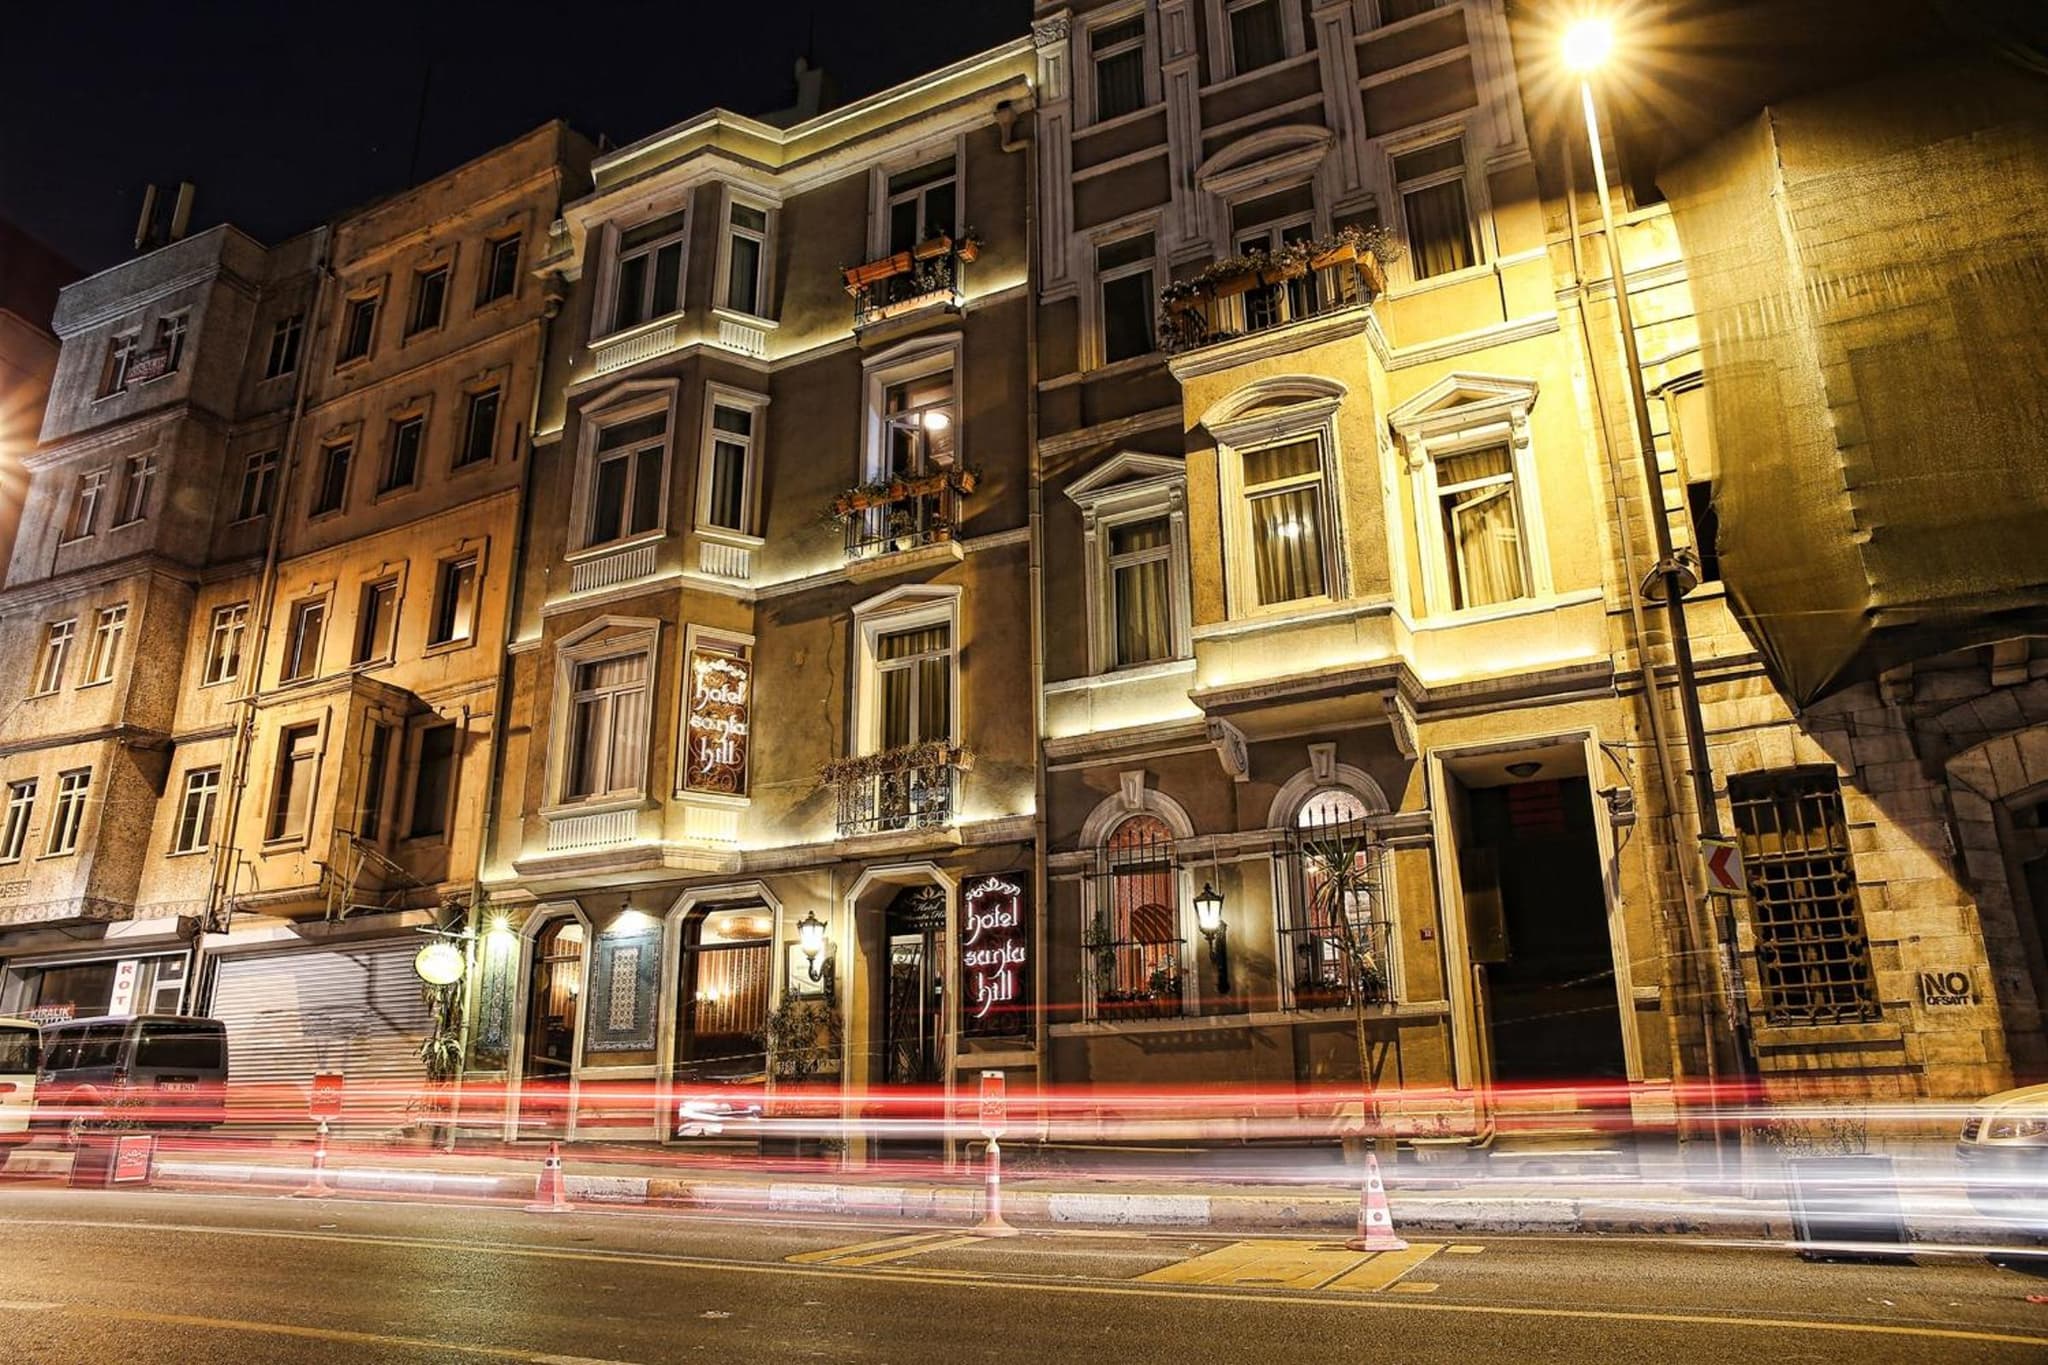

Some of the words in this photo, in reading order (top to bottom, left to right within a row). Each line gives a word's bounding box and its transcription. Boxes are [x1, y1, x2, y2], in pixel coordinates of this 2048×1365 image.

[694, 671, 746, 710] hotel
[689, 714, 749, 742] santa
[700, 736, 736, 774] hill
[964, 896, 1018, 946] hotel
[963, 939, 1026, 980] santa
[973, 970, 1013, 1018] hill
[1924, 971, 1970, 995] NO
